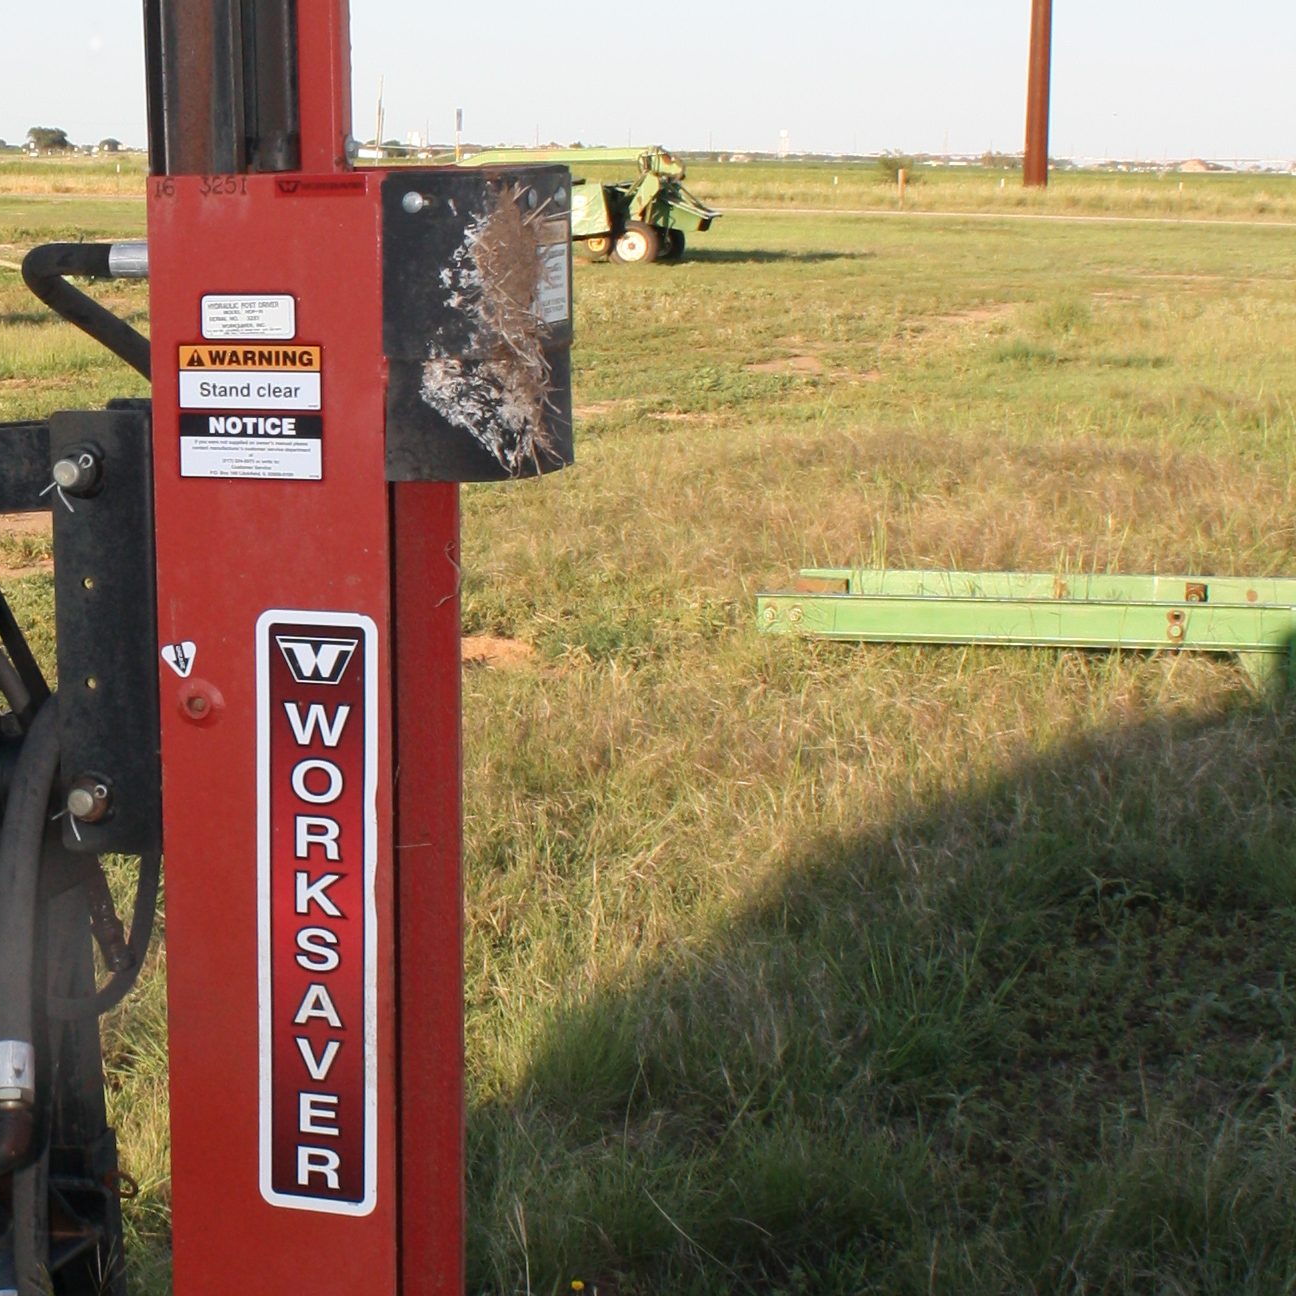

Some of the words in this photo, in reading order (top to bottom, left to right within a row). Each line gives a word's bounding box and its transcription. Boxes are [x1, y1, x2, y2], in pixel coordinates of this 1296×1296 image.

[208, 350, 313, 366] WARNING
[200, 381, 251, 398] Stand
[256, 383, 301, 399] clear
[208, 415, 297, 436] NOTICE
[283, 701, 352, 1191] WORKSAVER
